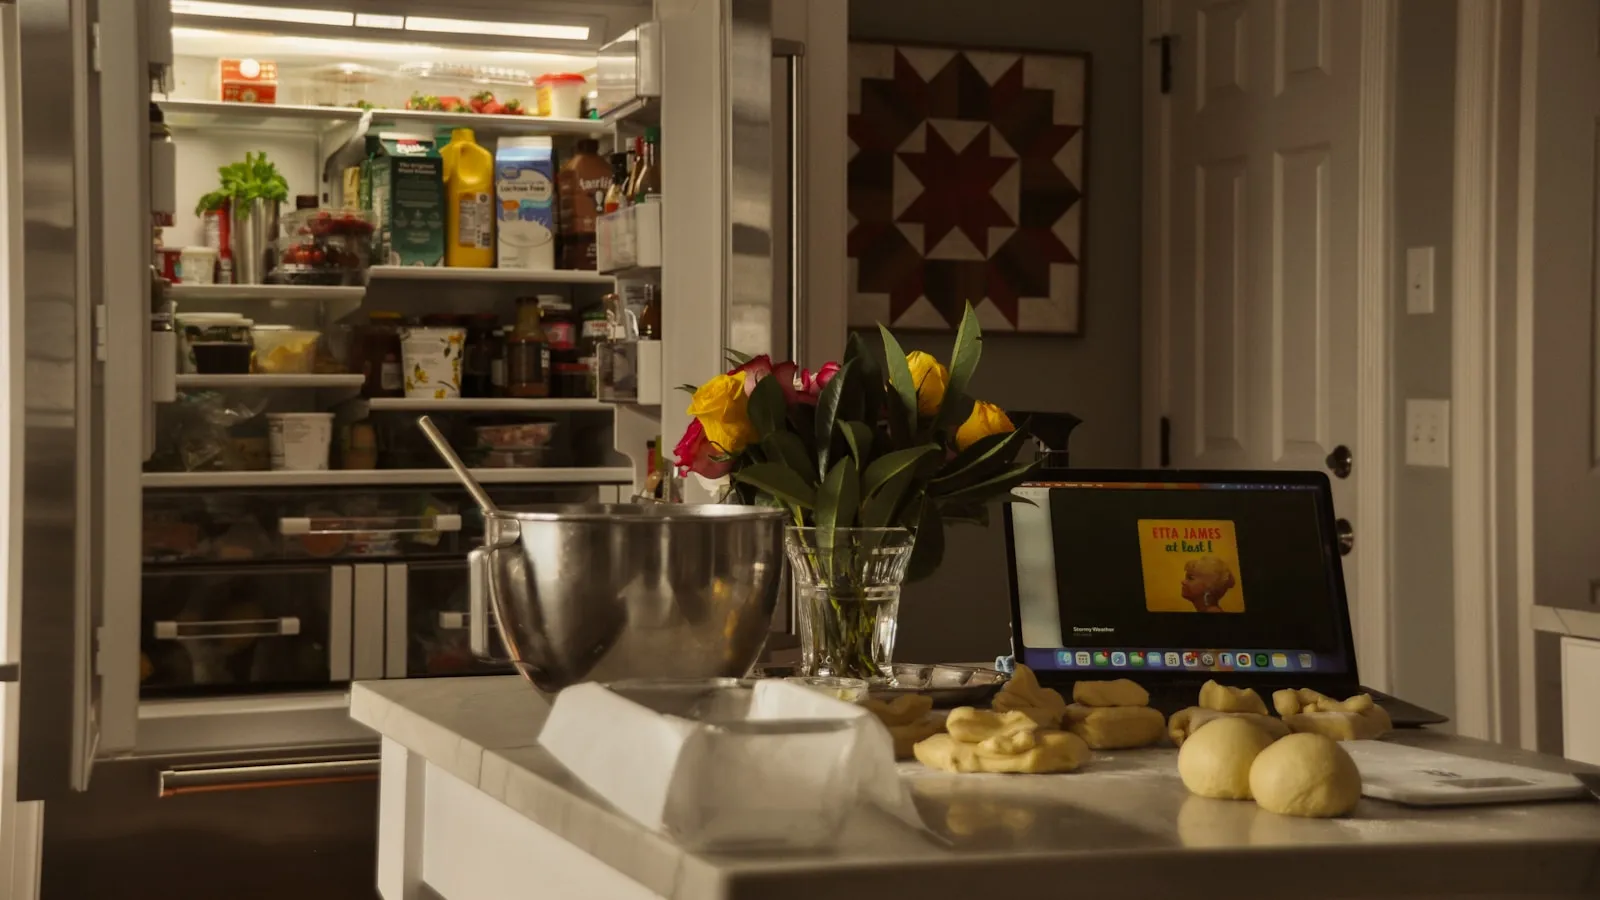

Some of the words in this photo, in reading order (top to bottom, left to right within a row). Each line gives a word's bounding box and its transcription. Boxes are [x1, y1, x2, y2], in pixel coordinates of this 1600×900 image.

[500, 184, 528, 192] Lactose
[530, 184, 546, 192] Free
[1152, 527, 1179, 539] ETTA
[1183, 527, 1222, 539] JAMES
[1165, 541, 1178, 552] at
[1168, 657, 1177, 665] 31
